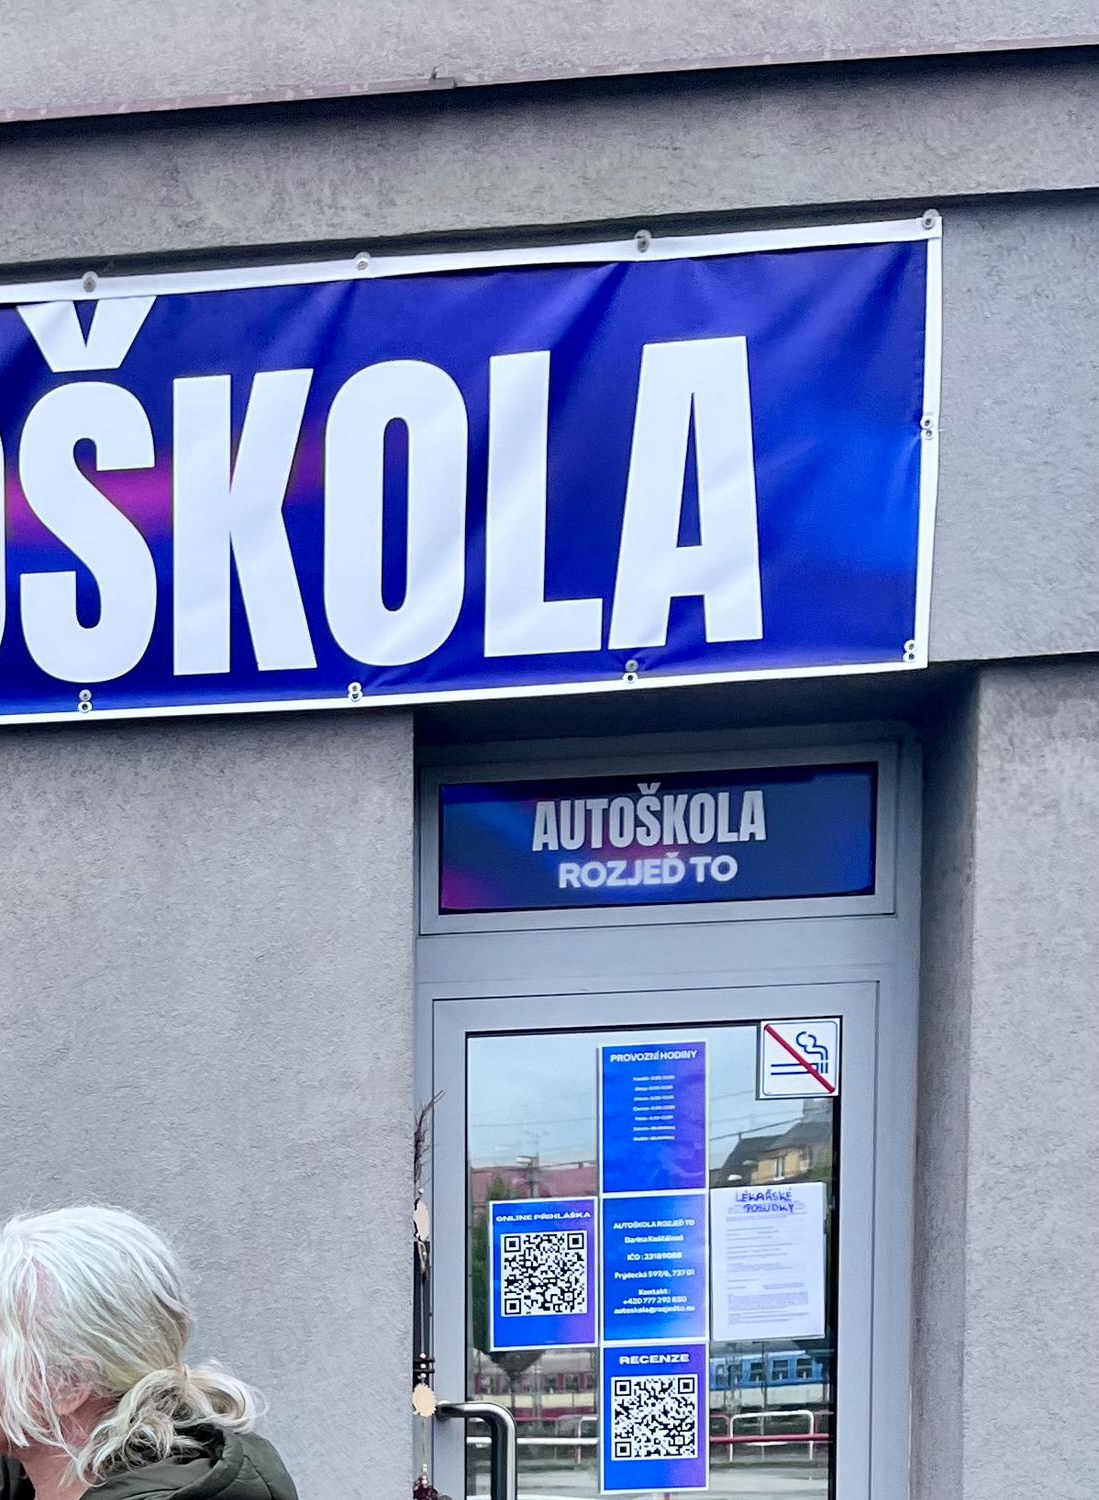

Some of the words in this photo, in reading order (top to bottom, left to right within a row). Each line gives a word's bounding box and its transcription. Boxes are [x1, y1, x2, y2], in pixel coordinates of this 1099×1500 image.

[532, 782, 766, 852] AUTOŠKOLA
[558, 851, 686, 888] ROZJEĎ
[690, 855, 739, 883] TO
[610, 1050, 660, 1062] PROVOZNÍ
[660, 1050, 697, 1060] HODINY
[496, 1214, 533, 1222] ONLINE
[619, 1353, 690, 1365] RECENZE
